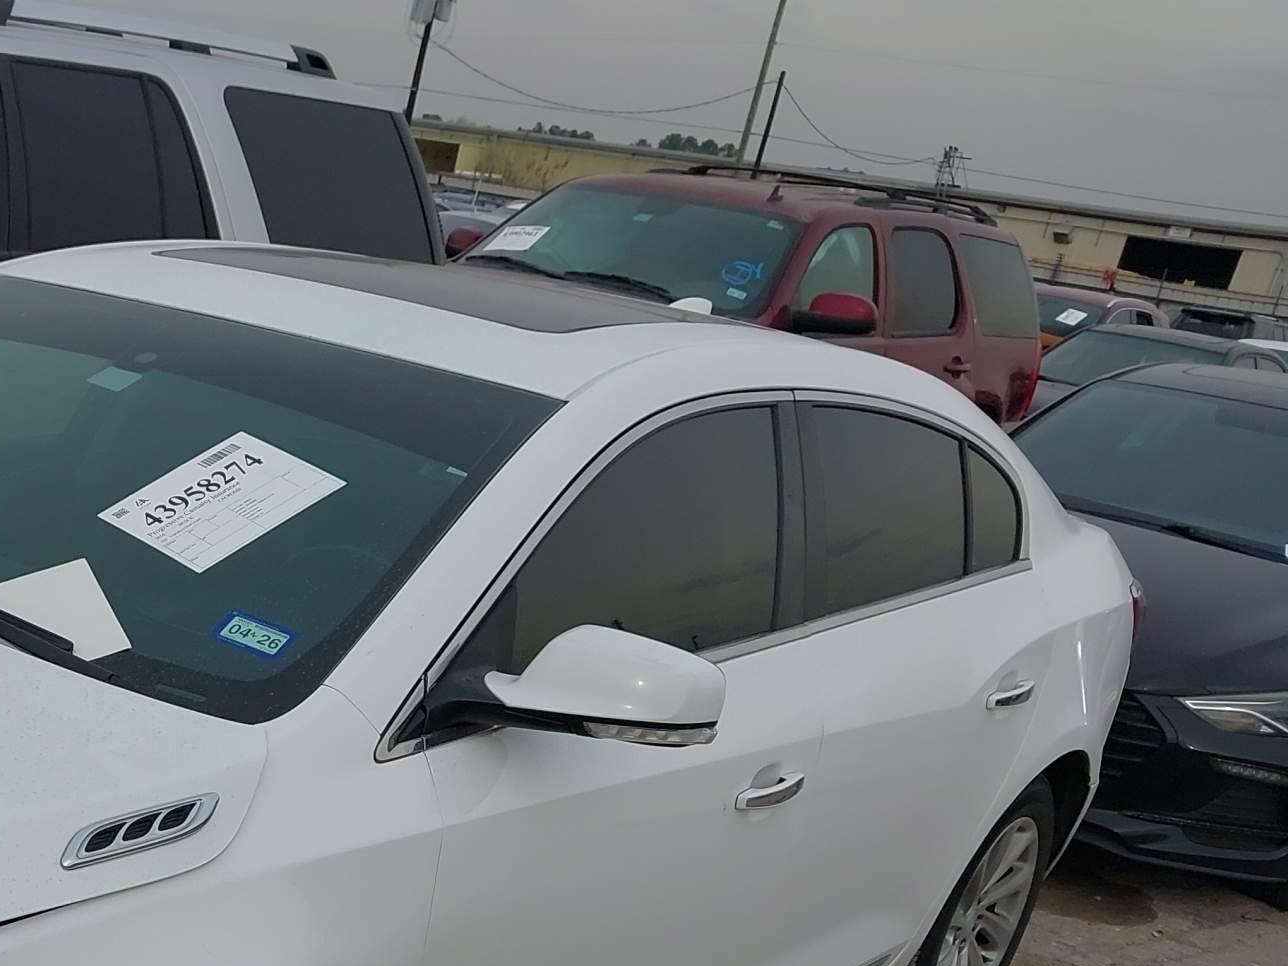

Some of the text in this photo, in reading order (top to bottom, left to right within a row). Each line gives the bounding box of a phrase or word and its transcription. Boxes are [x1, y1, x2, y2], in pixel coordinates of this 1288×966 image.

[144, 453, 264, 527] 43958274
[228, 623, 282, 649] 04 26
